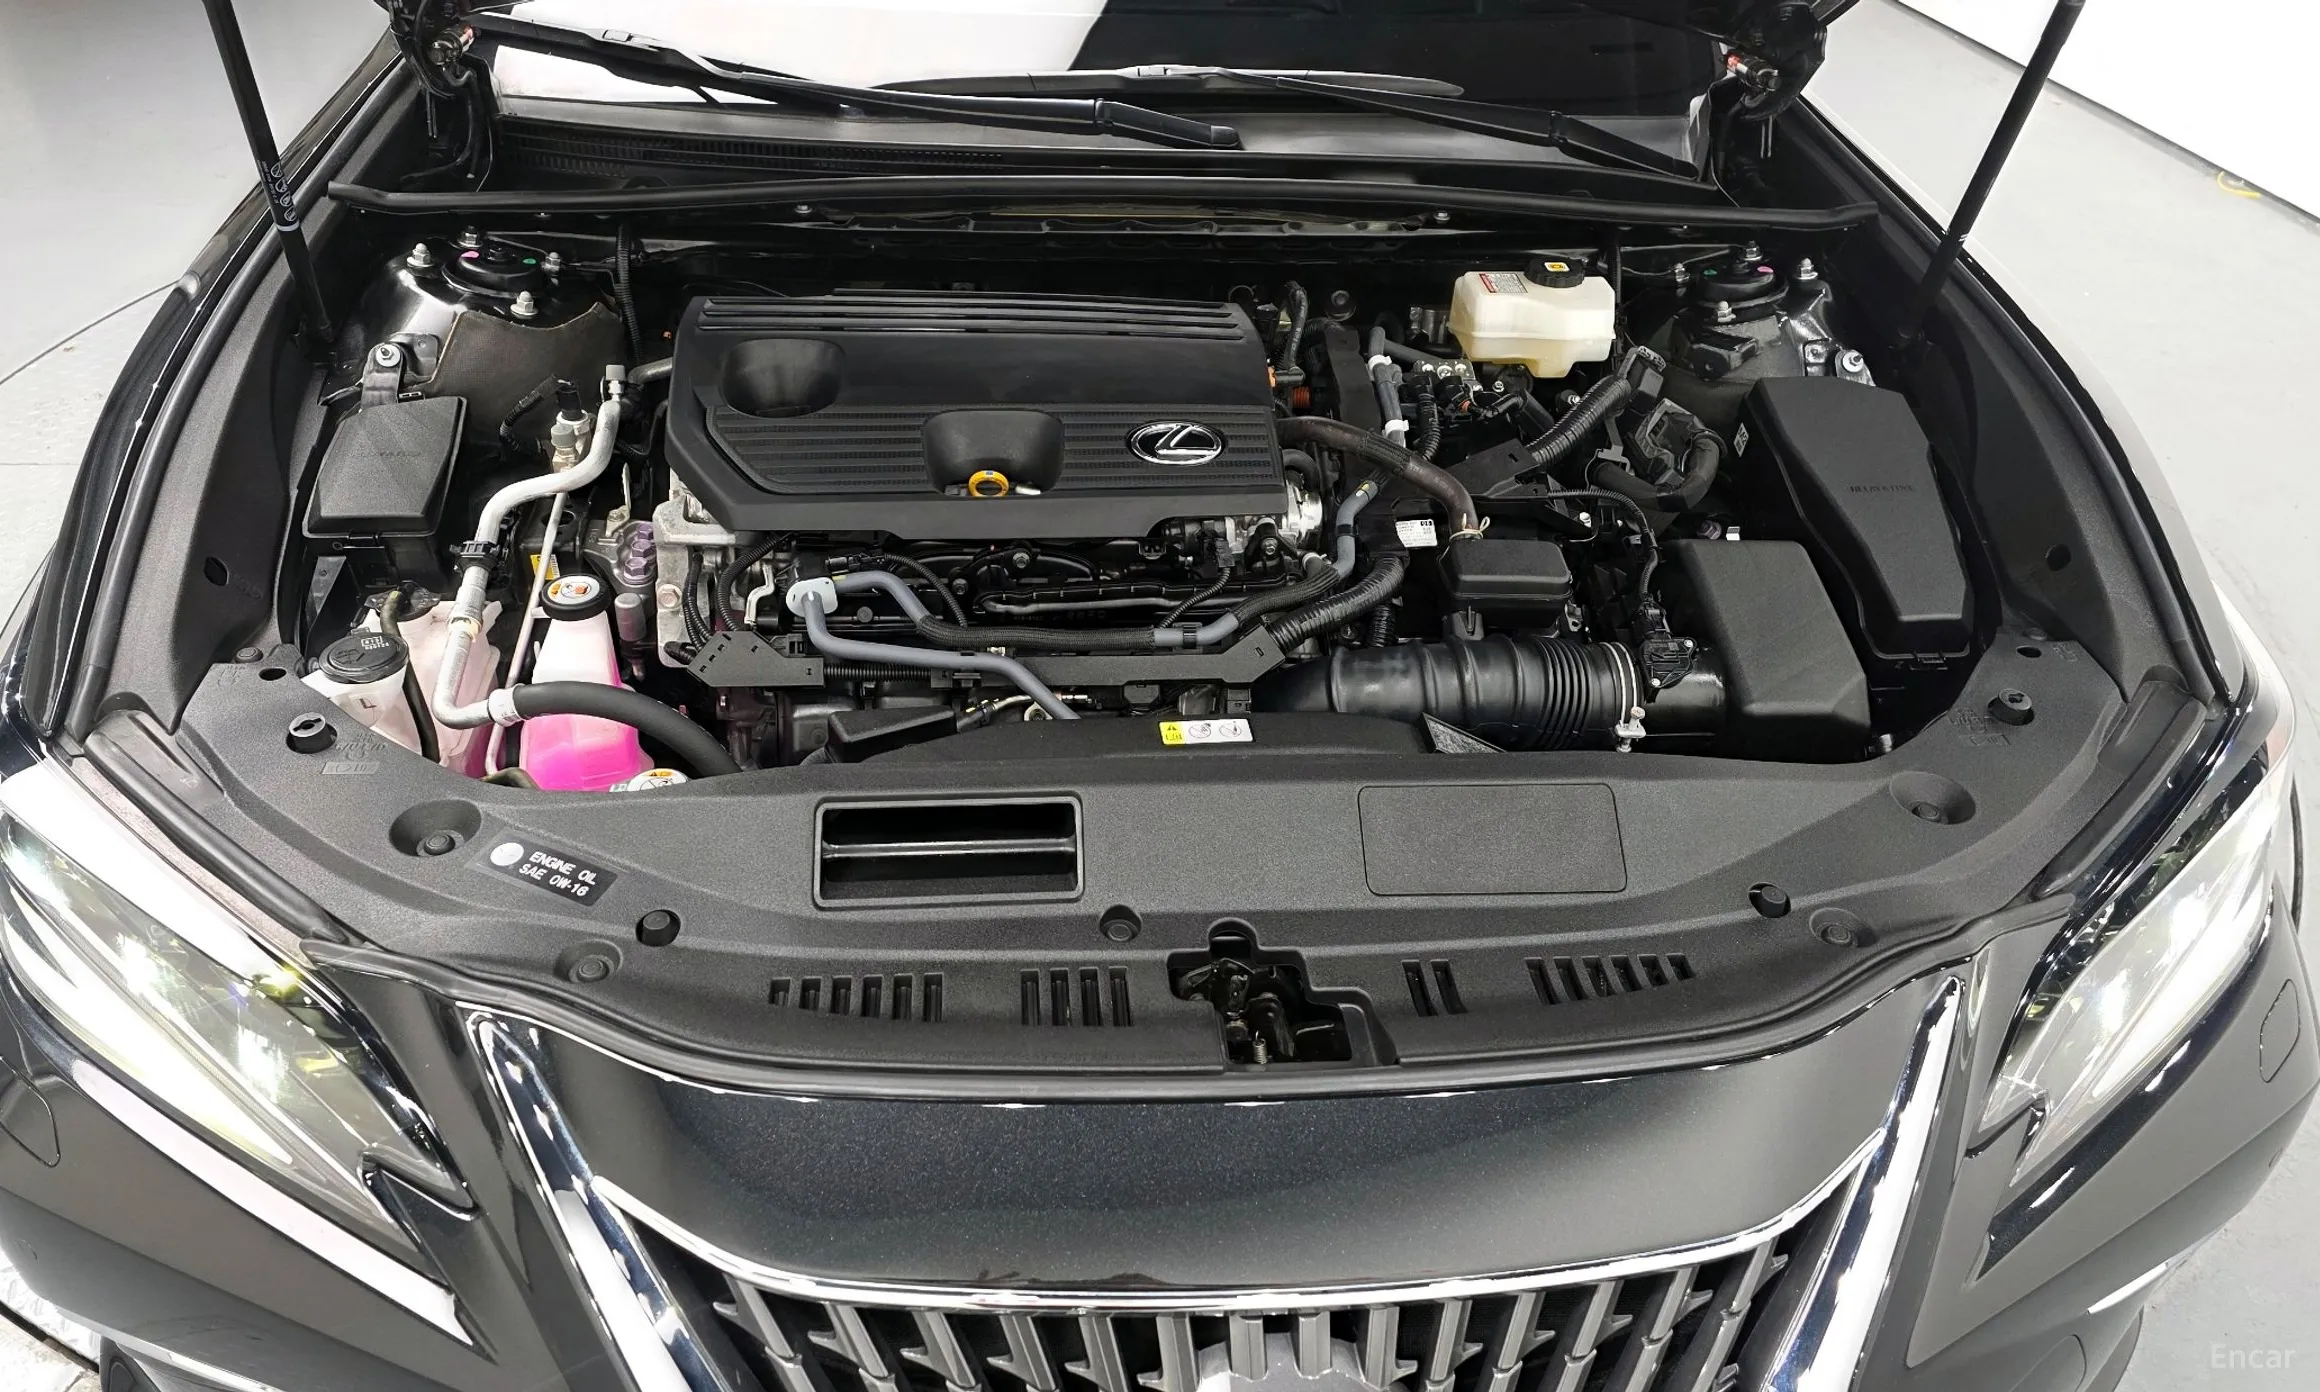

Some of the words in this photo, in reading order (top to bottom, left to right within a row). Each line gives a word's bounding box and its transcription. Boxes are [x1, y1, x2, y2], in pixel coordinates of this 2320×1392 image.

[518, 863, 548, 880] SAE
[549, 875, 590, 897] 0W-16
[528, 851, 577, 875] ENGINE
[577, 869, 598, 886] OIL
